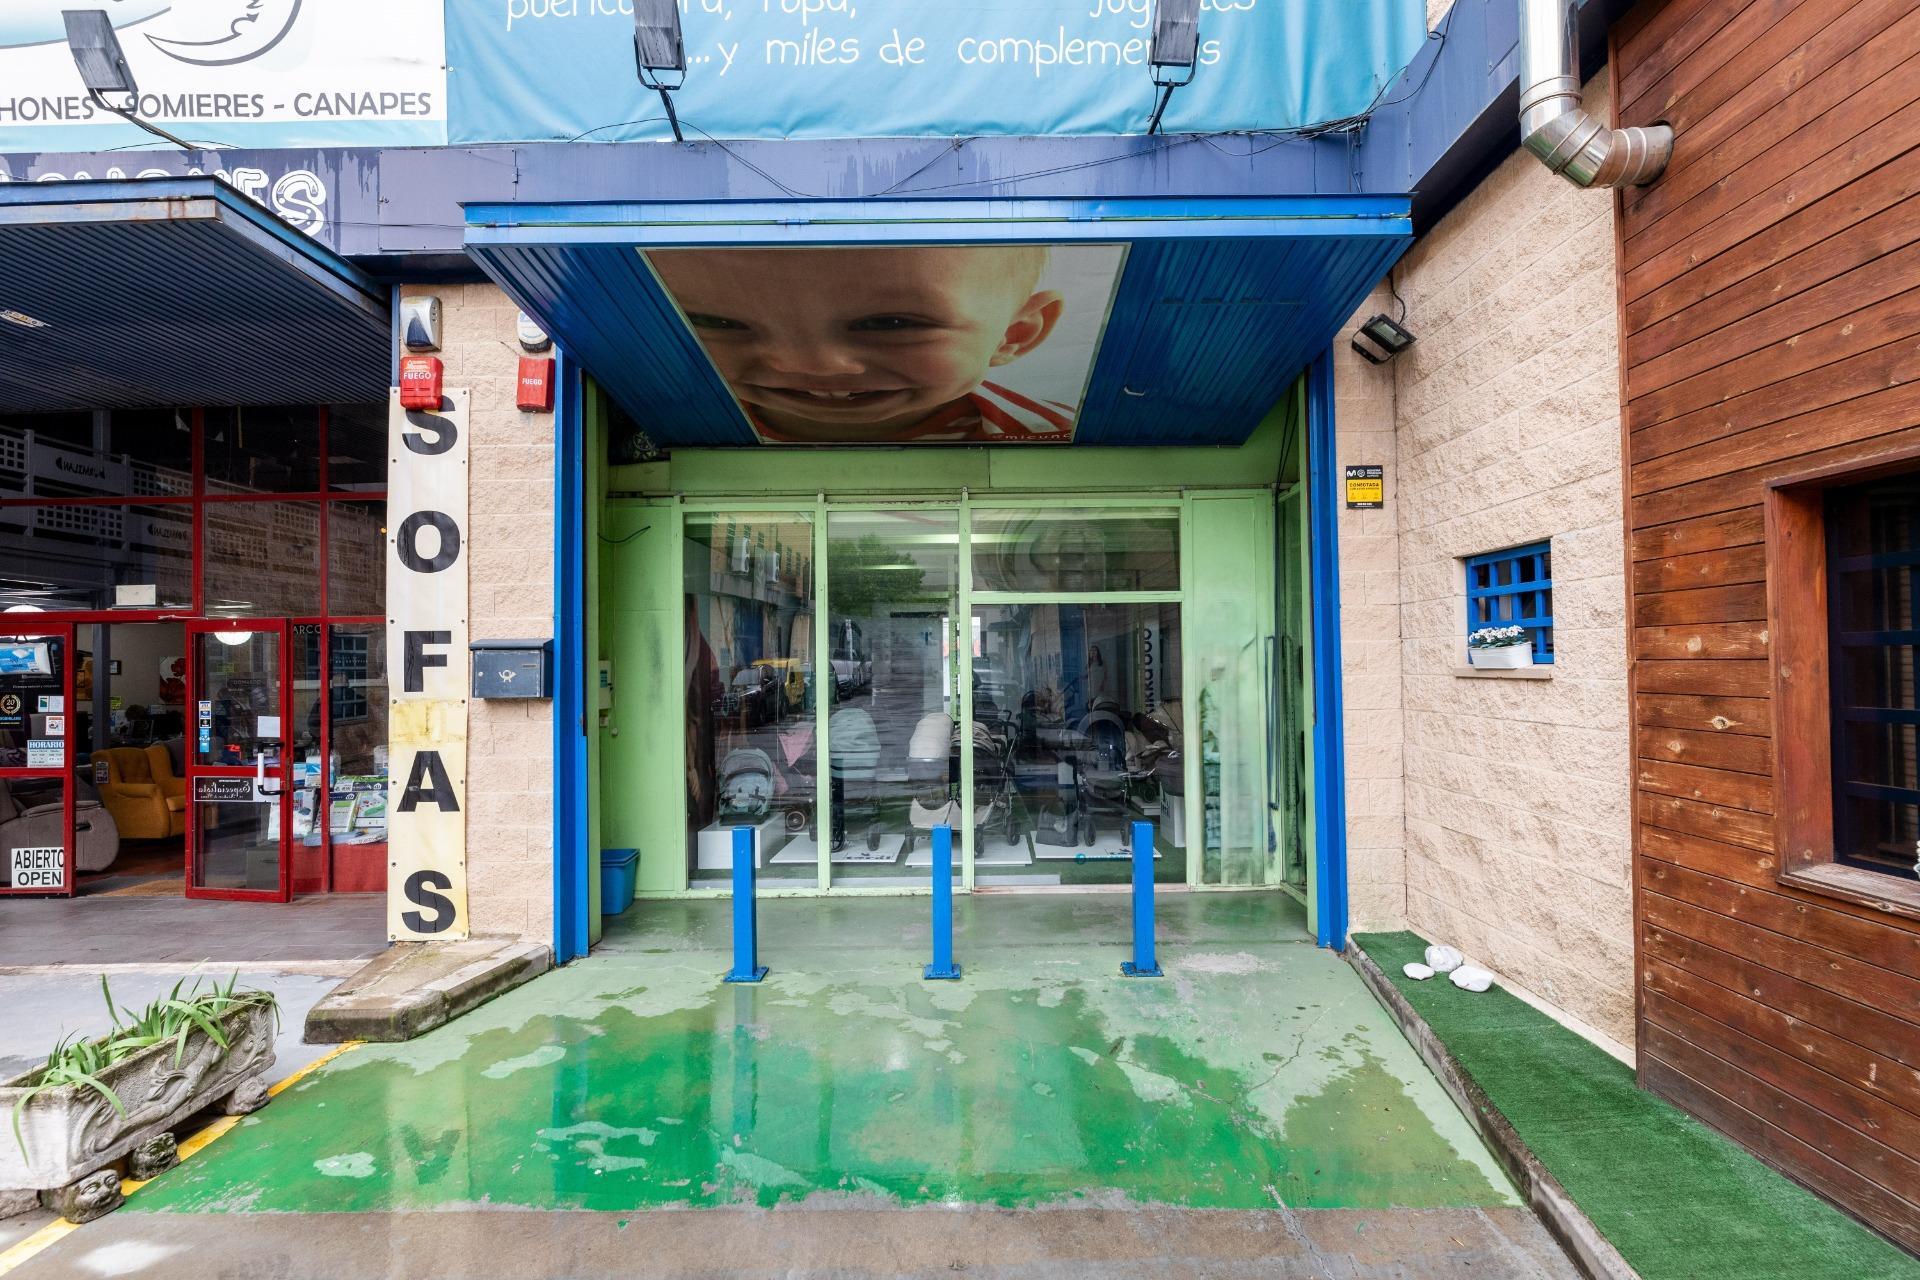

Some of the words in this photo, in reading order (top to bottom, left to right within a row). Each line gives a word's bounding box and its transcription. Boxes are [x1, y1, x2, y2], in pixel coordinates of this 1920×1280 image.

[766, 27, 859, 65] miles
[879, 28, 925, 66] de
[957, 26, 1221, 77] complemes
[293, 92, 432, 117] CANAPES
[403, 372, 432, 380] FUEGO
[522, 378, 543, 386] FUEGO
[396, 394, 461, 934] SOFAS
[29, 741, 65, 749] HORARIO
[15, 849, 64, 869] ABIERTO
[18, 871, 61, 886] OPEN
